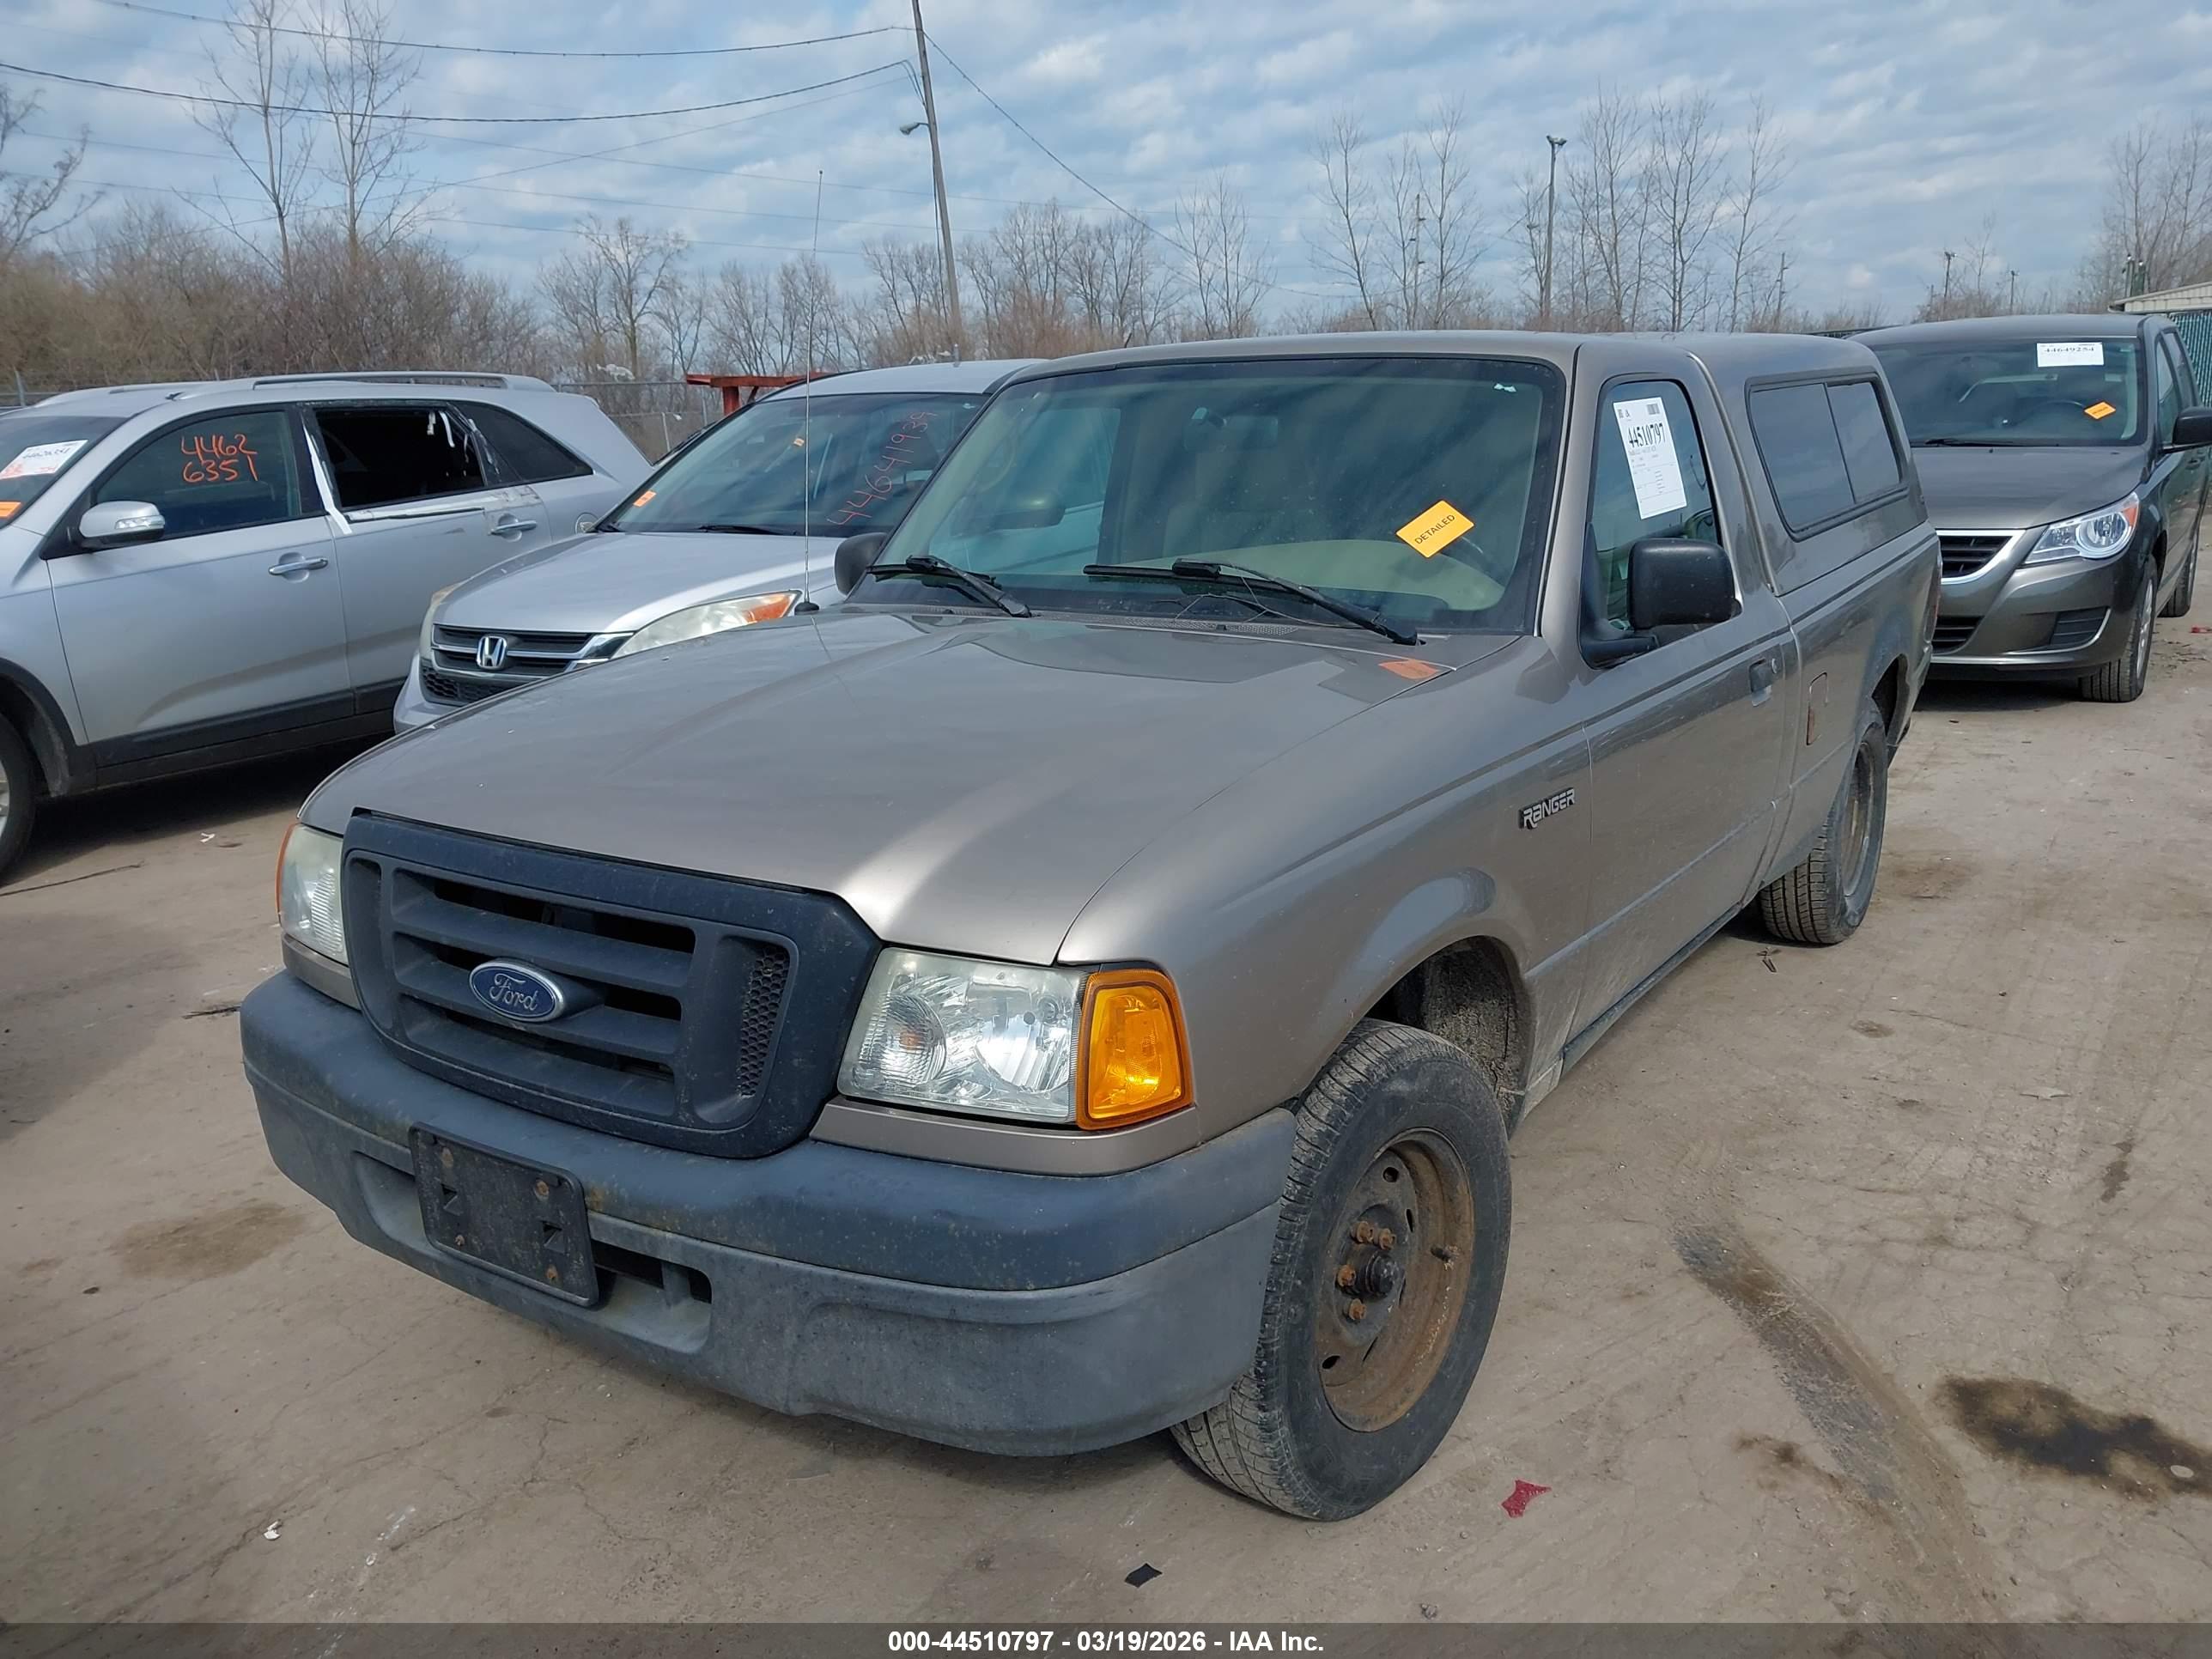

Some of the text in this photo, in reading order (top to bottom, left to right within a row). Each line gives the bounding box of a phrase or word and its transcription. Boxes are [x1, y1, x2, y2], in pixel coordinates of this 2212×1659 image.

[181, 434, 258, 465] 4462
[1628, 422, 1666, 447] 44510797
[183, 454, 258, 483] 6351
[1414, 514, 1455, 544] DETAILED
[1521, 788, 1575, 829] RANGER
[489, 973, 538, 1011] Ford
